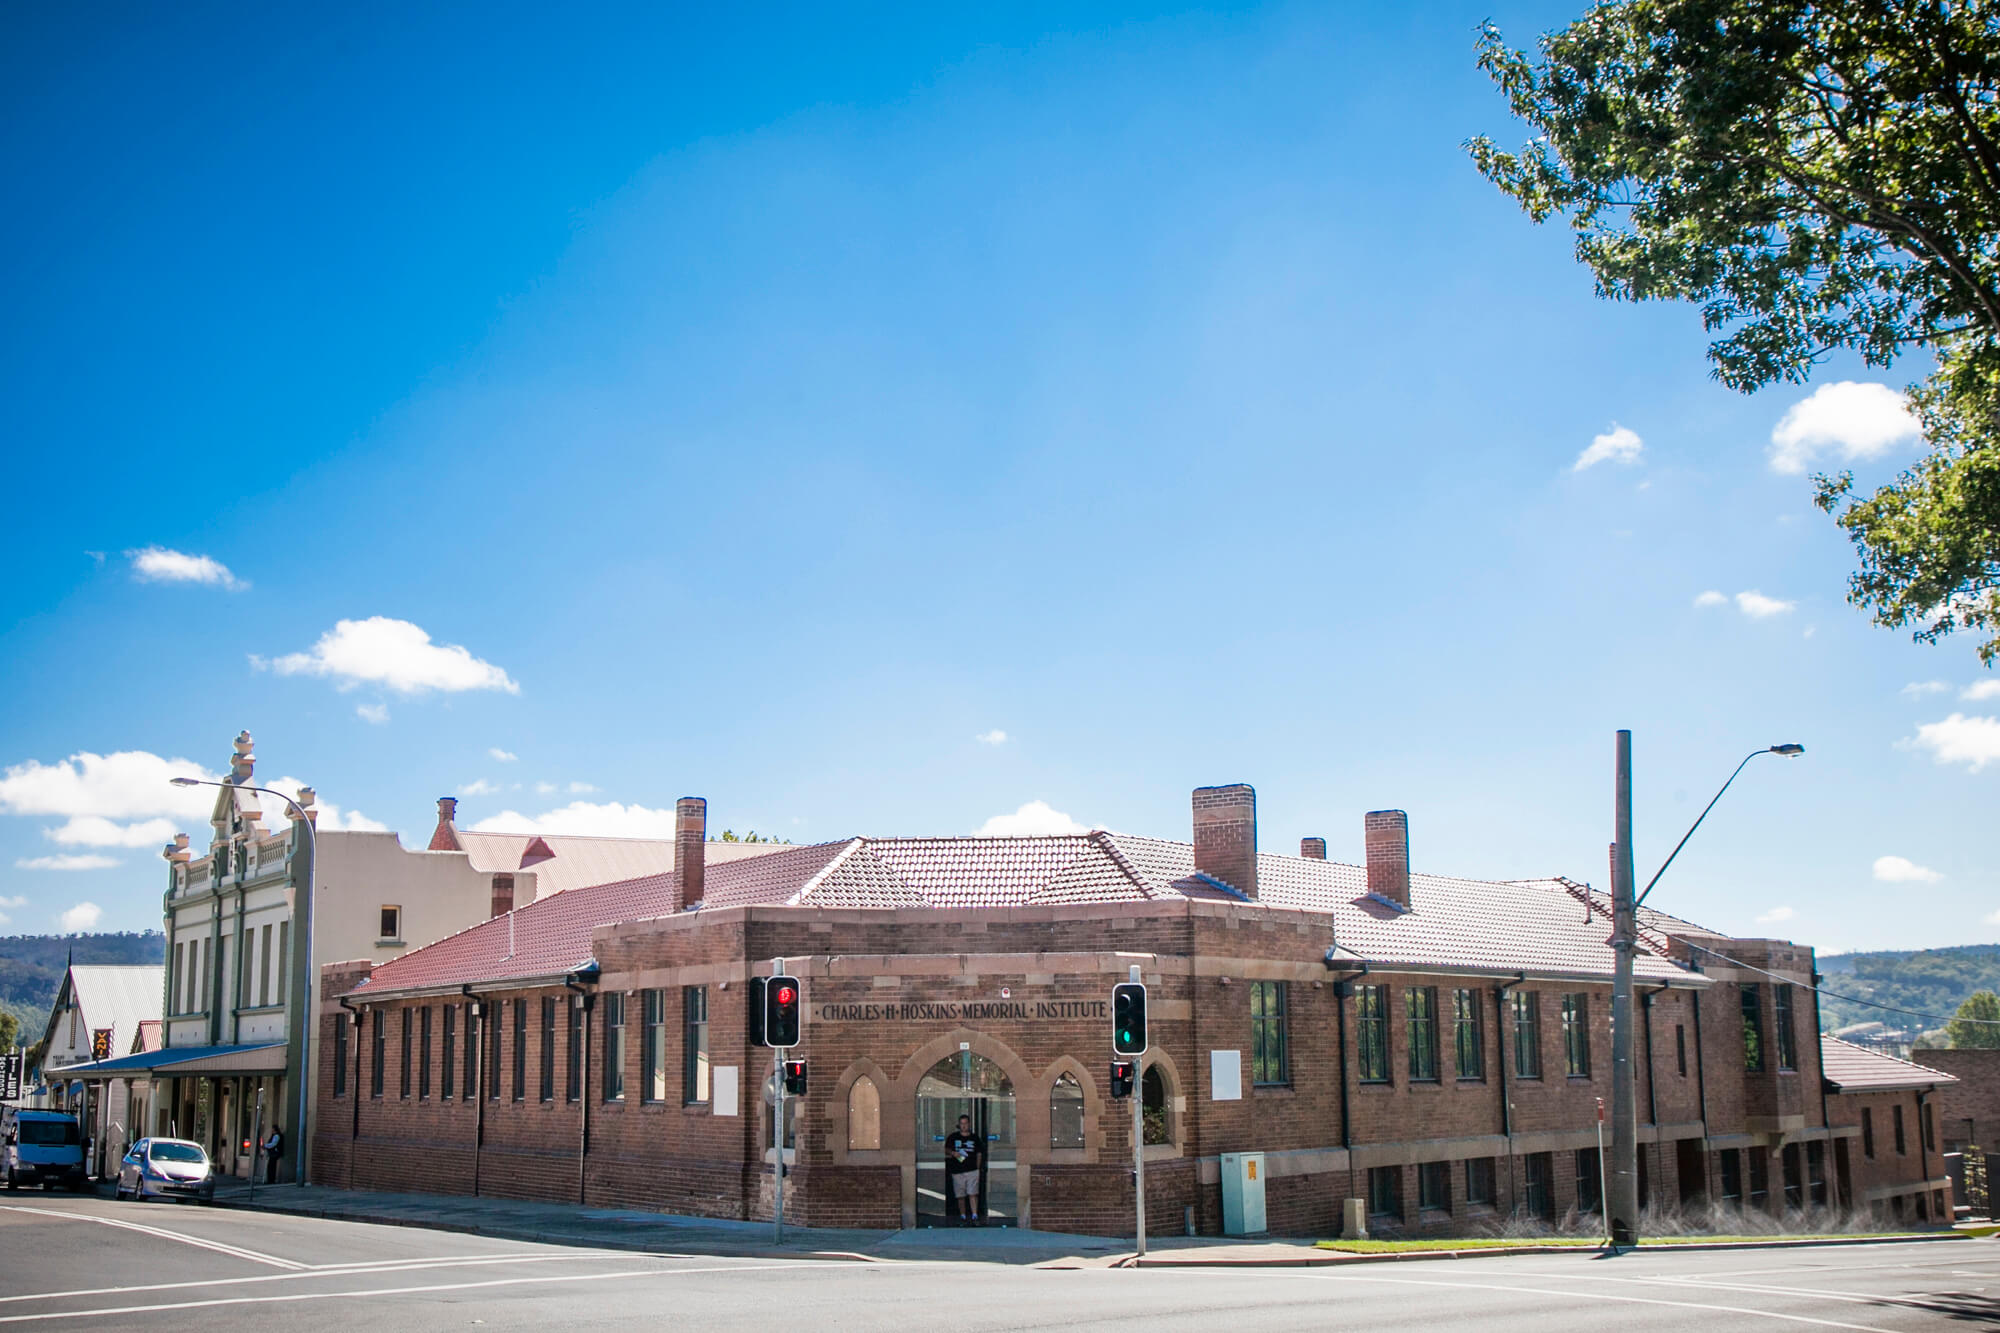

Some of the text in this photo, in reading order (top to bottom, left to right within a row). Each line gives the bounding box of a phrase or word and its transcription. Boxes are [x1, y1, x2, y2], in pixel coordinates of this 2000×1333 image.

[822, 1001, 1107, 1020] CHARLES H HOSKINS MEMORIAL INSTITUTE
[7, 1056, 19, 1098] TILES
